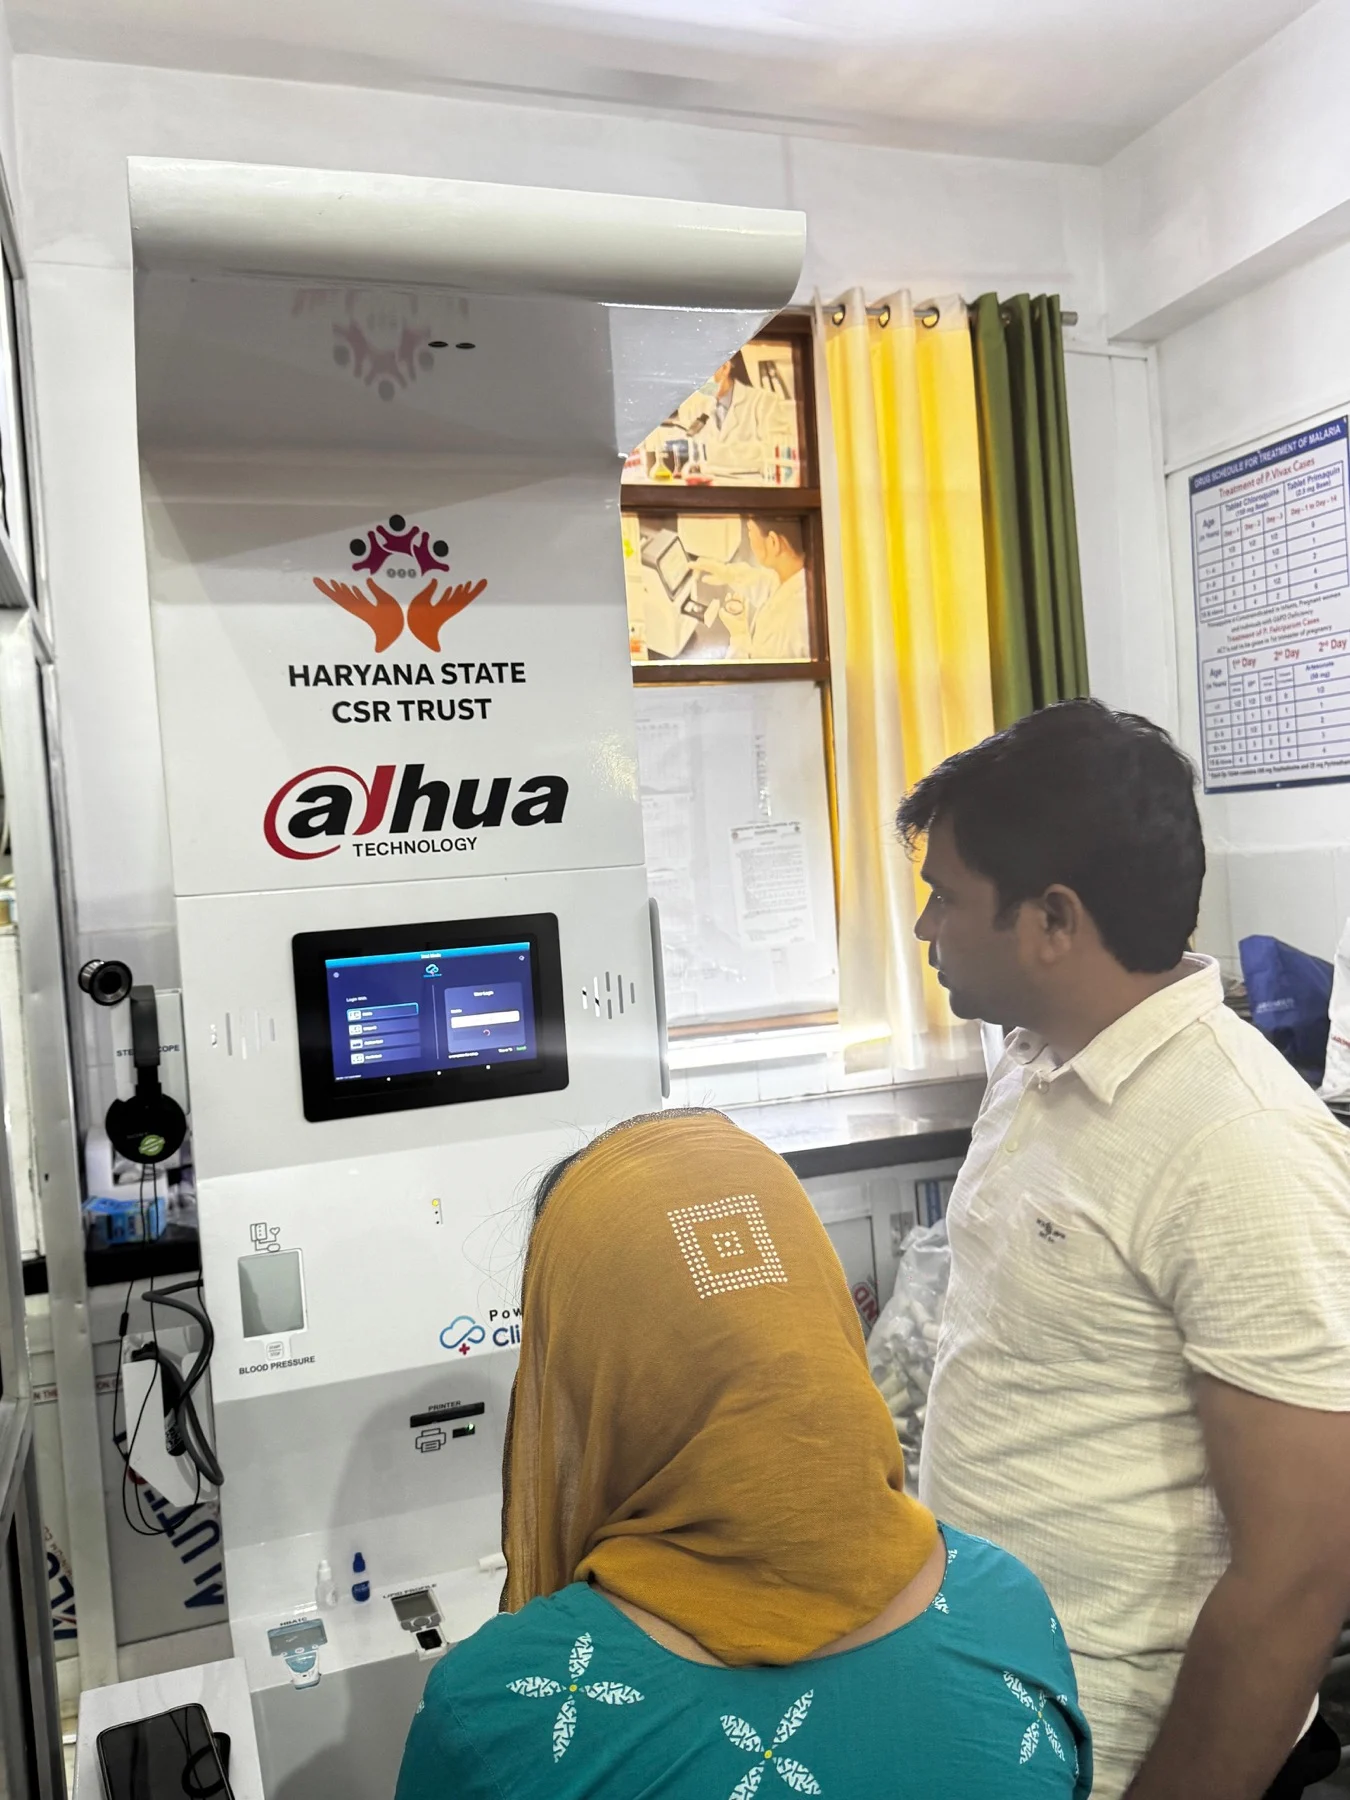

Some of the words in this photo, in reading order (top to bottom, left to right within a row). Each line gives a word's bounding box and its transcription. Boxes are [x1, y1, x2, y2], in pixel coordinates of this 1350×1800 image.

[1244, 456, 1259, 471] FOR
[1258, 441, 1297, 463] TREATMENT
[1298, 435, 1308, 448] OF
[1308, 424, 1341, 444] MALARIA
[1218, 478, 1255, 498] Treatment
[1255, 473, 1264, 486] of
[1292, 458, 1315, 472] Cases
[1241, 658, 1256, 669] Day
[1284, 648, 1300, 659] Day
[1330, 639, 1347, 651] Day
[288, 664, 434, 687] HARYANA
[441, 662, 526, 685] STATE
[1209, 668, 1222, 678] Age
[332, 700, 391, 723] CSR
[397, 698, 492, 721] TRUST
[352, 837, 478, 857] TECHNOLOGY
[116, 1044, 180, 1057] STECOPE
[489, 1307, 522, 1322] Pow
[492, 1324, 521, 1347] Cli
[239, 1363, 269, 1375] BLOOD
[270, 1356, 316, 1370] PRESSURE
[428, 1400, 461, 1412] PRINTER
[382, 1590, 403, 1600] LIPID
[404, 1582, 437, 1595] PROFILE
